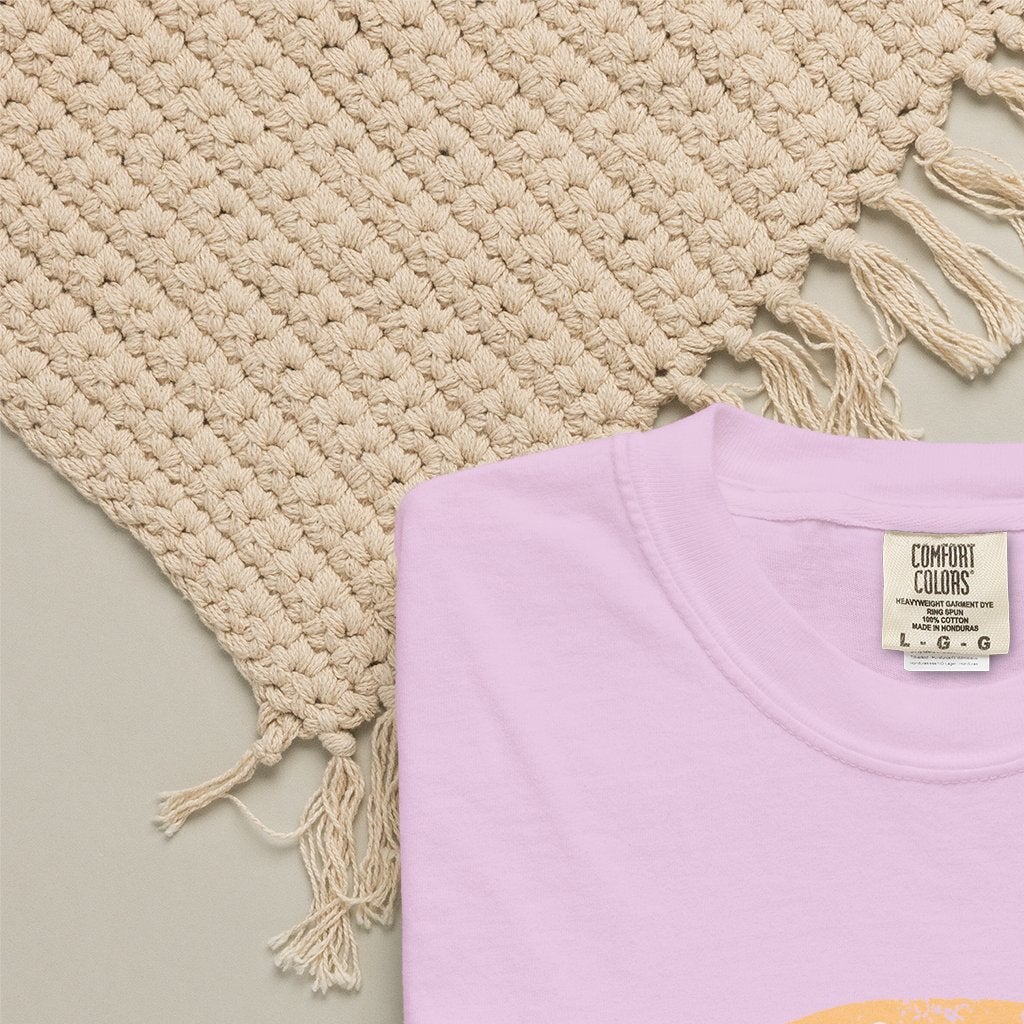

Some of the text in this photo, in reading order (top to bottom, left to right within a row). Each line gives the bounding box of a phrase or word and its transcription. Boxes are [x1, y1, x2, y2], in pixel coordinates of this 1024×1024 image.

[911, 543, 976, 568] COMFORT
[896, 598, 994, 609] HEAVYWEIGHT GARMENT DYE
[945, 608, 964, 616] SPUN
[922, 616, 939, 624] 100%
[912, 623, 932, 631] MADE
[941, 624, 979, 632] HONDURAS
[900, 632, 910, 647] L
[937, 635, 950, 650] G
[977, 636, 991, 650] G
